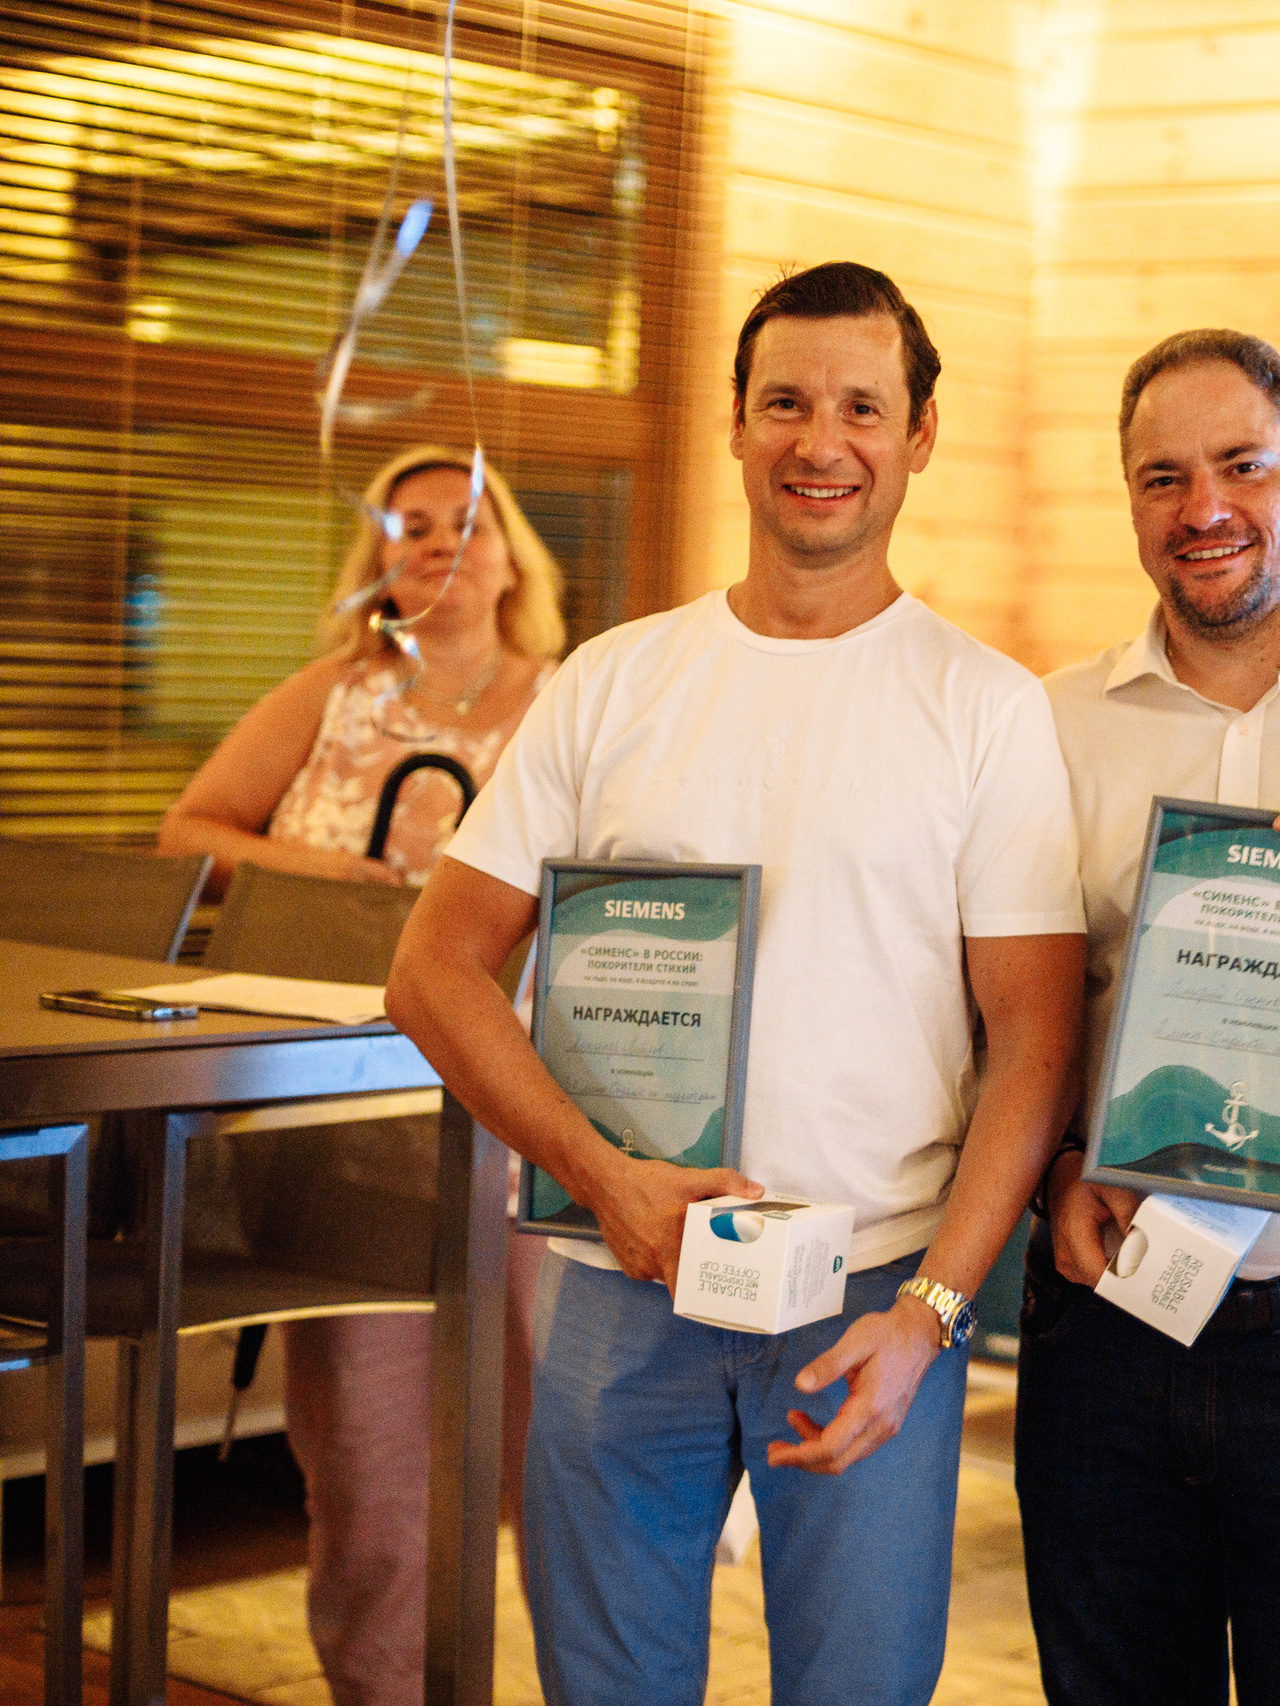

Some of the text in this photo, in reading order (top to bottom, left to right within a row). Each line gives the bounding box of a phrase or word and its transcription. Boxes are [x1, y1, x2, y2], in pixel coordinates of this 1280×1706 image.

[1193, 889, 1270, 907] «СИМЕНС»
[604, 900, 686, 920] SIEMENS
[581, 946, 703, 962] «СИМЕНС» В РОССИИ:
[587, 960, 697, 974] ПОКОРИТЕЛИ СТИХИЙ
[573, 1005, 702, 1028] НАГРАЖДАЕТСЯ
[700, 1261, 760, 1280] COFFEE CUP
[698, 1279, 758, 1301] REUSABLE
[1165, 1257, 1204, 1314] REUSABLE
